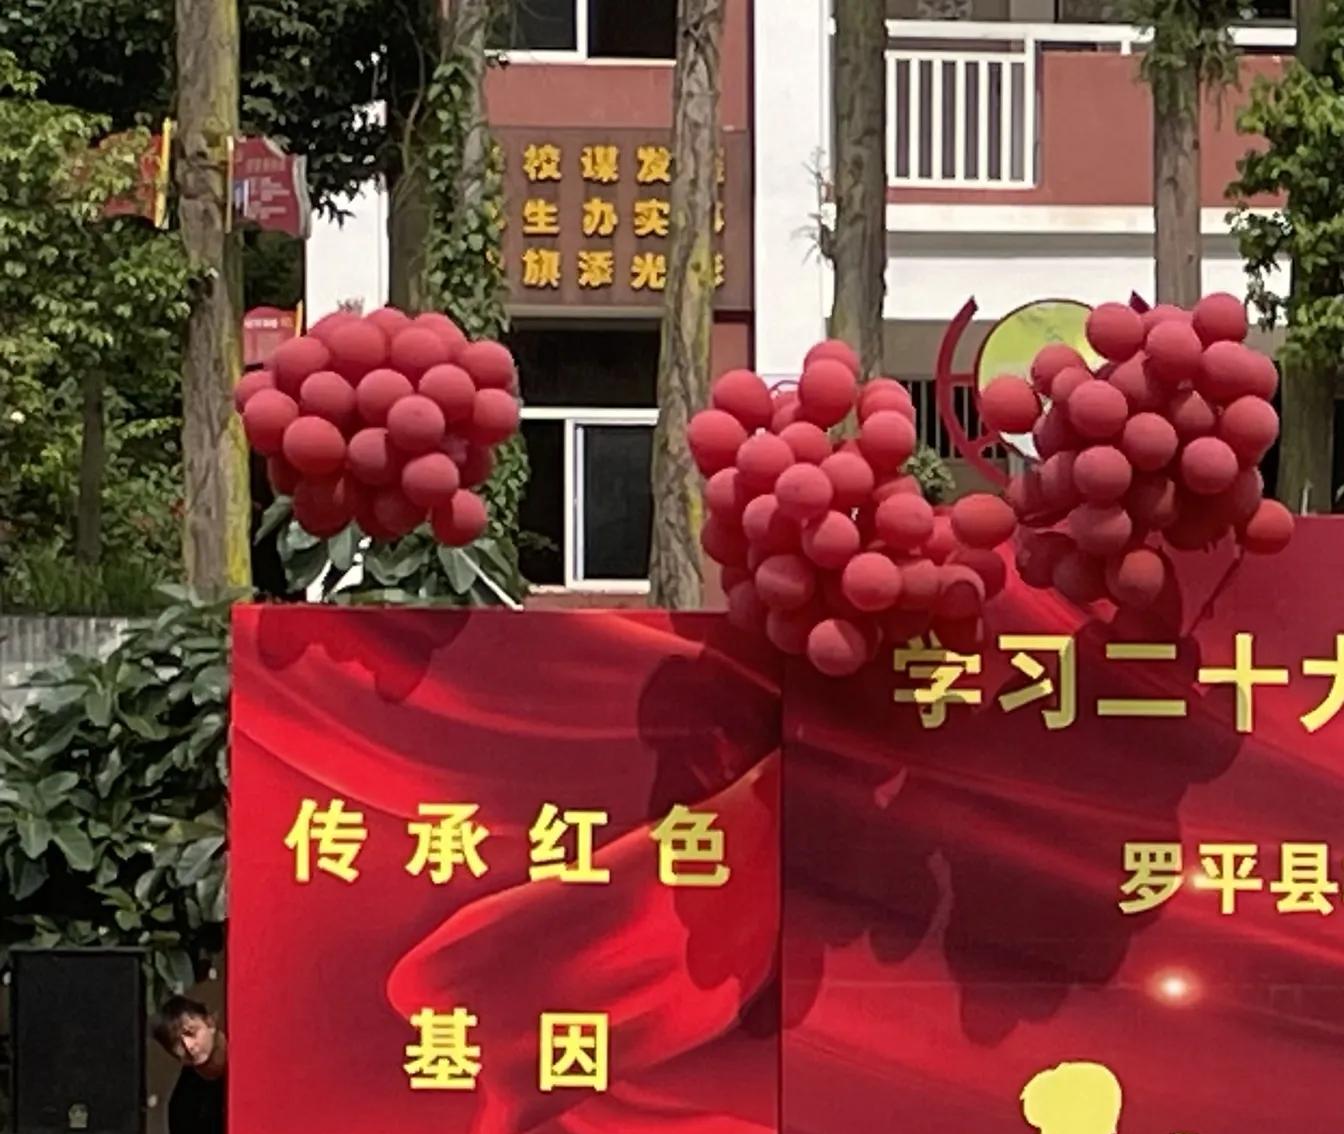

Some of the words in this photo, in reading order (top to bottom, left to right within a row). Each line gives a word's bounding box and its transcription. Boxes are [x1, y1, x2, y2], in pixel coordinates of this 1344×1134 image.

[490, 143, 725, 184] 校谋发
[490, 198, 725, 238] 生办实
[488, 248, 725, 291] 旗添光
[283, 799, 732, 887] 传承红色
[403, 1007, 609, 1092] 基因
